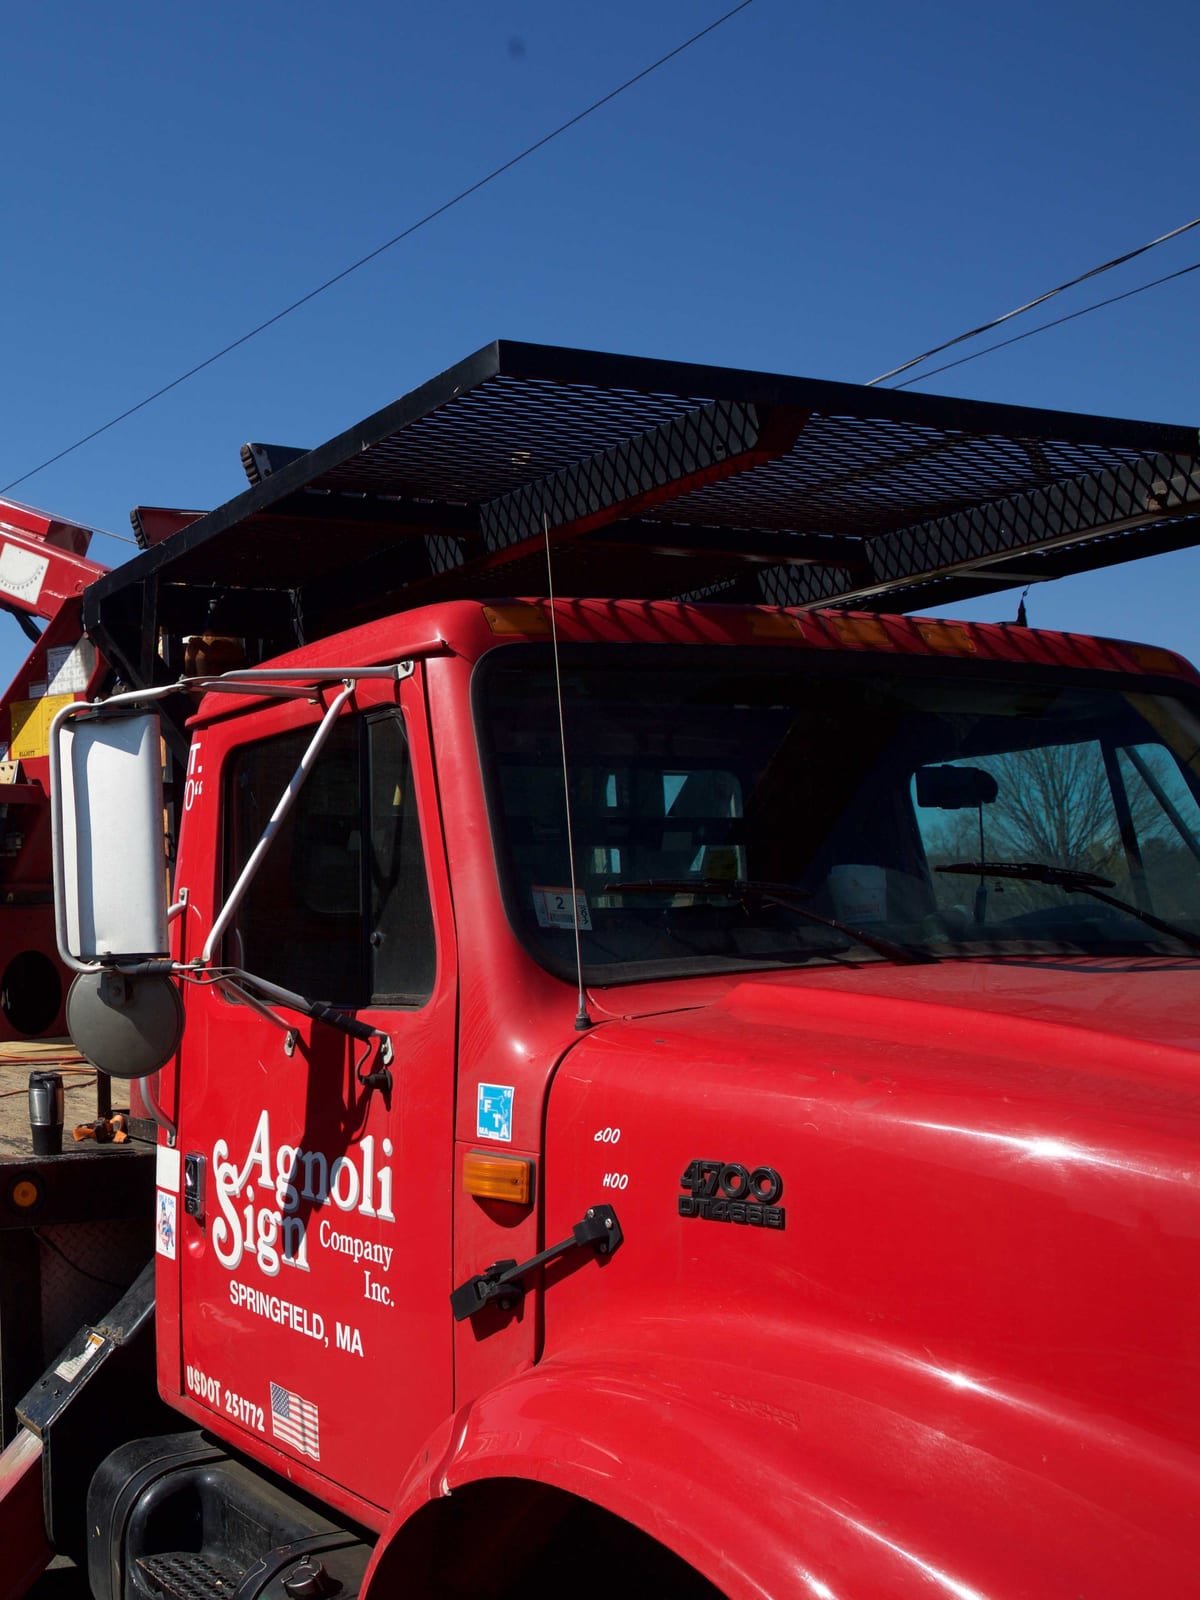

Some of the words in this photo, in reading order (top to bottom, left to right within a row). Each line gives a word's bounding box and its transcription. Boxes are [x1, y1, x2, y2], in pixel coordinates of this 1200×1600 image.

[555, 896, 565, 909] 2
[593, 1126, 621, 1145] 600
[212, 1109, 395, 1222] Agnoli
[680, 1159, 784, 1206] 4700
[212, 1158, 310, 1276] Sign
[678, 1195, 786, 1231] DT466E
[319, 1219, 394, 1272] Company
[363, 1271, 395, 1307] Inc.
[229, 1279, 329, 1349] SPRINGFIELD,
[335, 1320, 364, 1357] MA
[186, 1364, 221, 1407] USDOT
[224, 1391, 266, 1433] 251772
